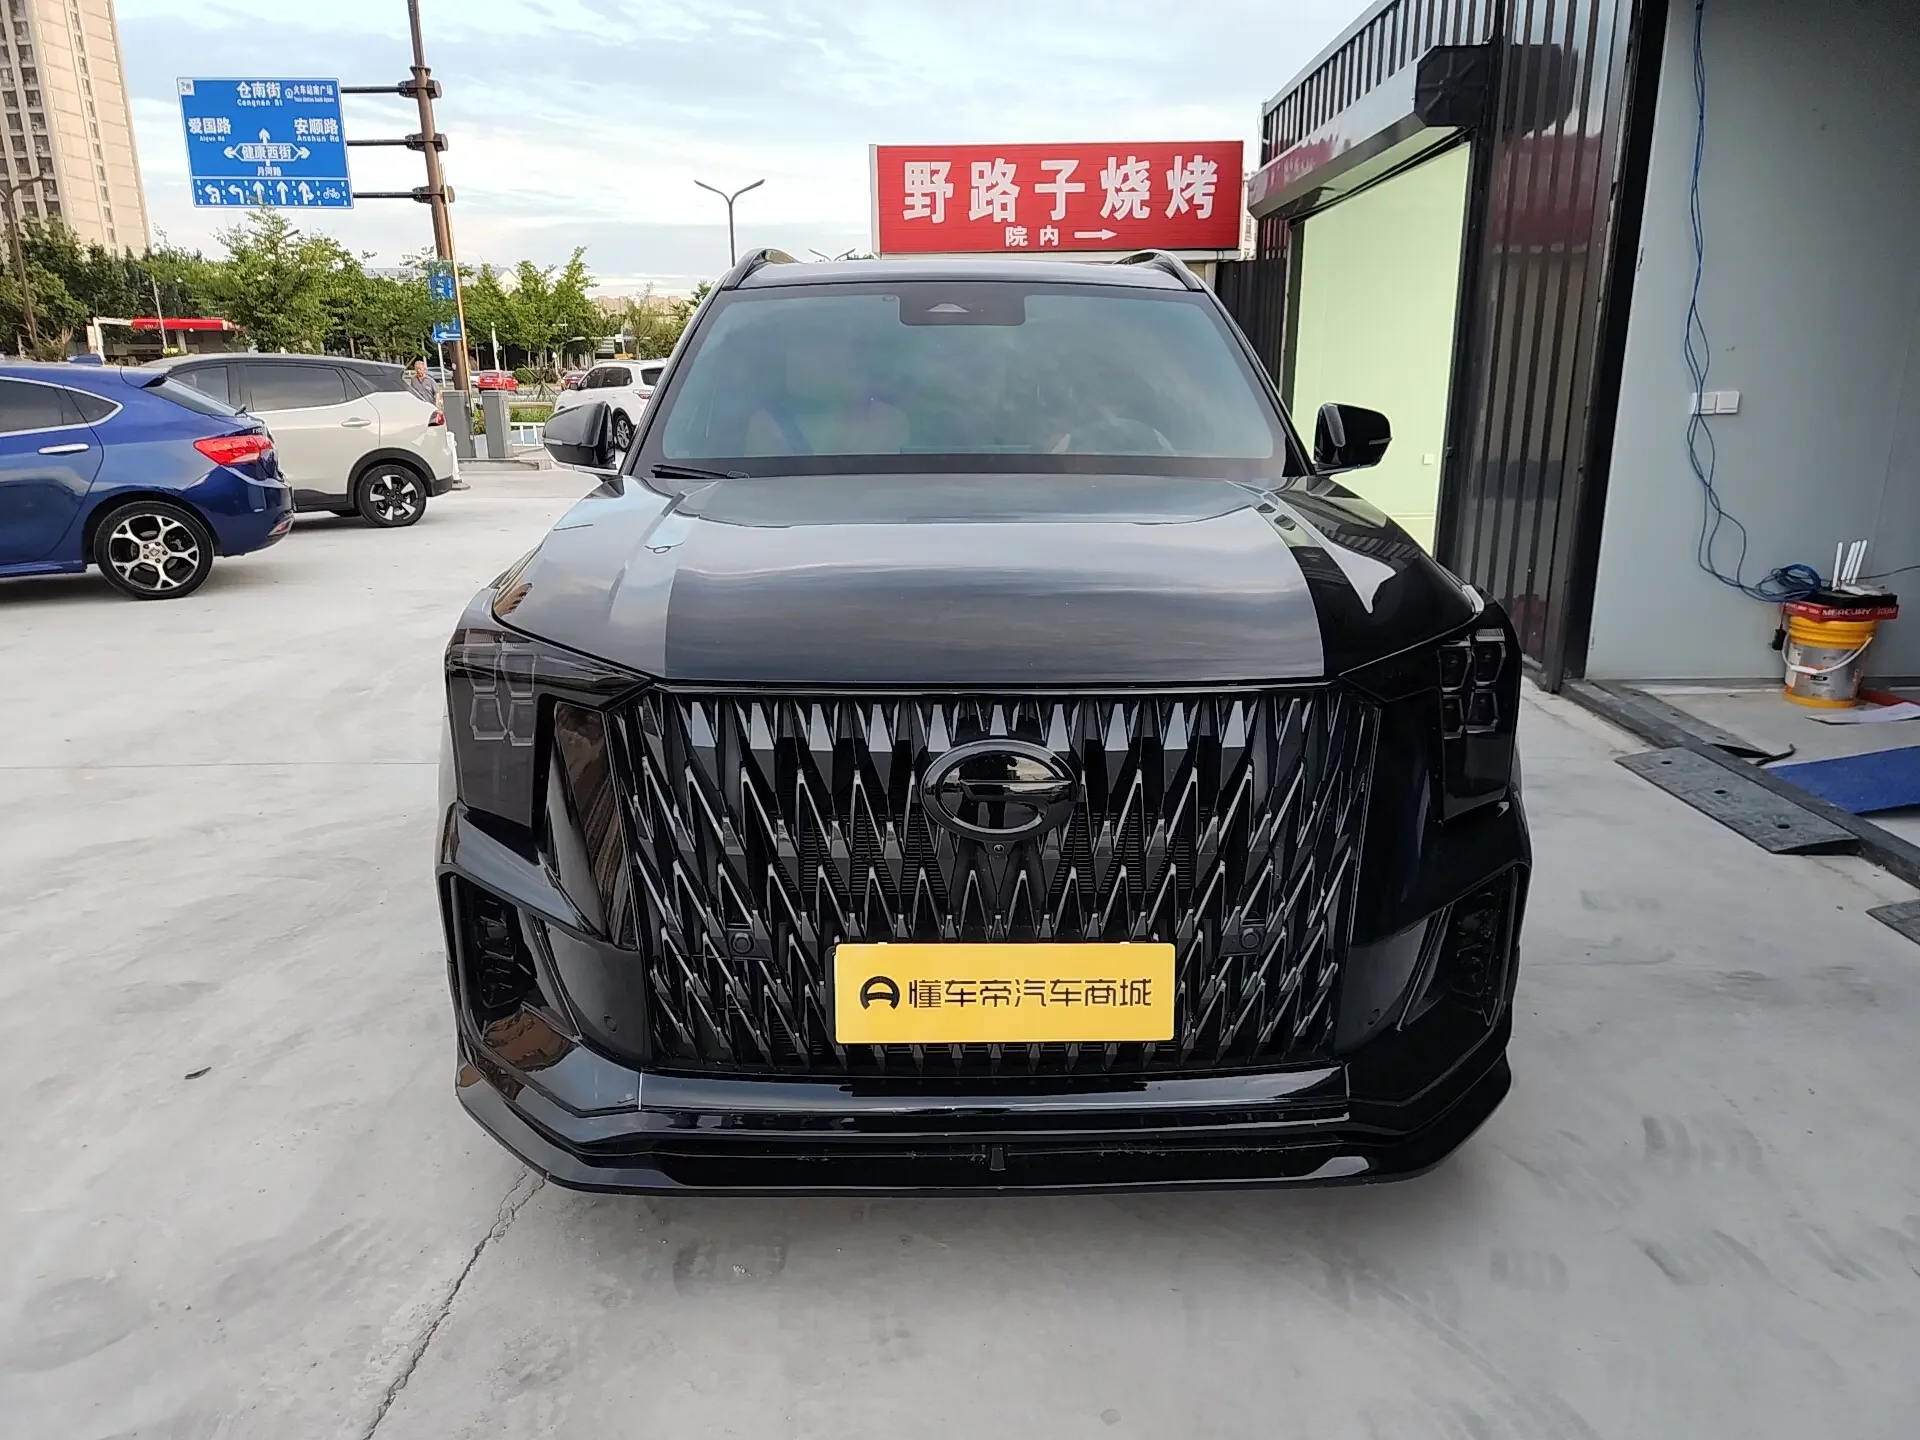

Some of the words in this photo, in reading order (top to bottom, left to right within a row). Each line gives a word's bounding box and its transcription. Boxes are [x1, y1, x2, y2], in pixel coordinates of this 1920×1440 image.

[236, 81, 281, 99] 仓南街
[237, 98, 271, 107] Cangnan
[188, 117, 232, 135] 爱国路
[294, 118, 339, 135] 安顺路
[297, 135, 326, 143] Anshun
[330, 135, 339, 143] Rd
[242, 144, 292, 160] 健康西街
[902, 154, 1218, 225] 野路子烧烤
[1005, 225, 1060, 247] 院内
[1822, 607, 1873, 617] MERCURY
[908, 978, 1152, 1009] 懂车帝汽车商城
